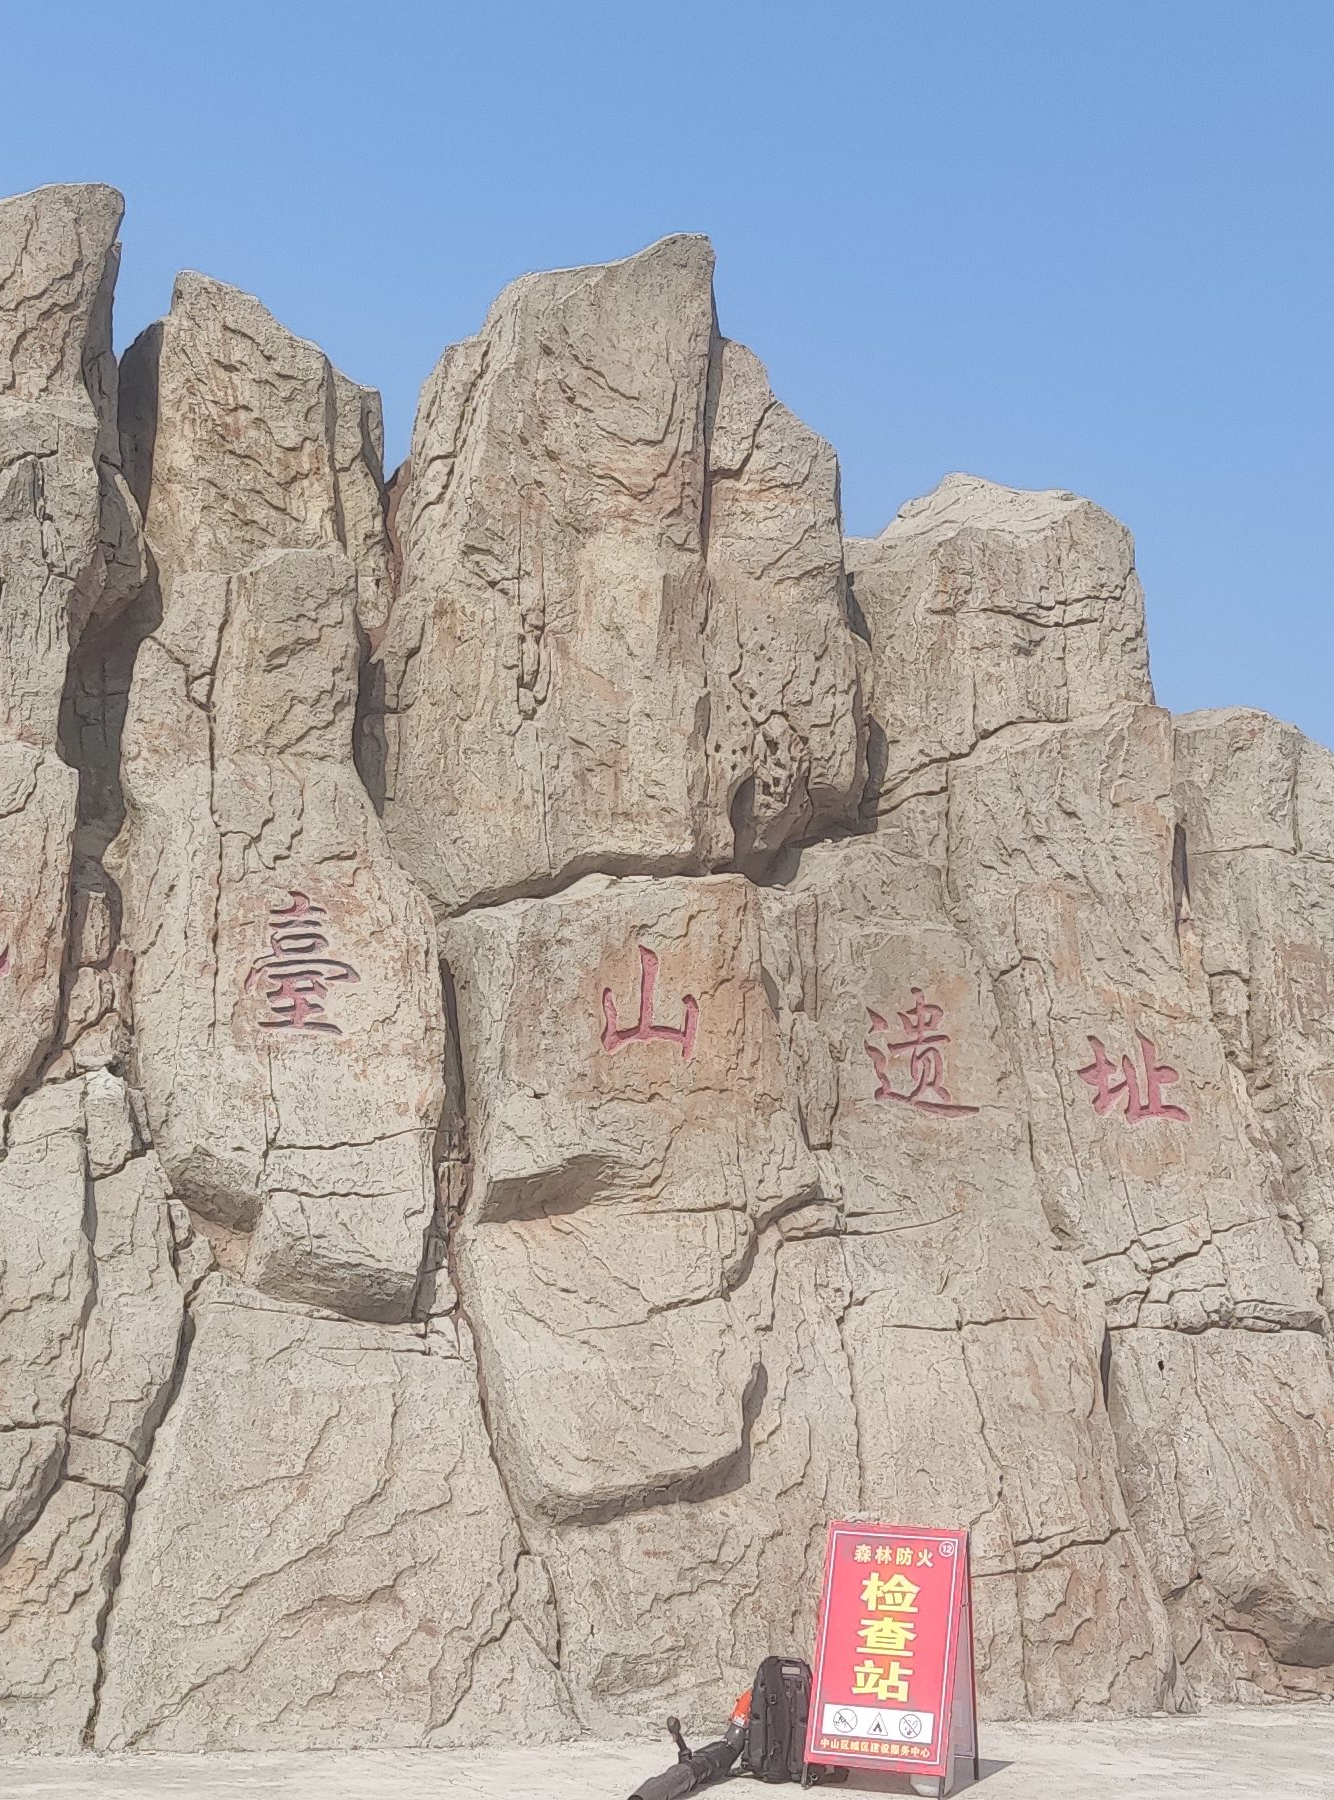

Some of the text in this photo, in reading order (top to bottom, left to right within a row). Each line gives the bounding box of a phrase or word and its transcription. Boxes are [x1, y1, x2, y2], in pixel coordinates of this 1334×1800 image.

[853, 1543, 935, 1568] 森林防火
[940, 1543, 954, 1554] 12
[851, 1571, 921, 1703] 检查站
